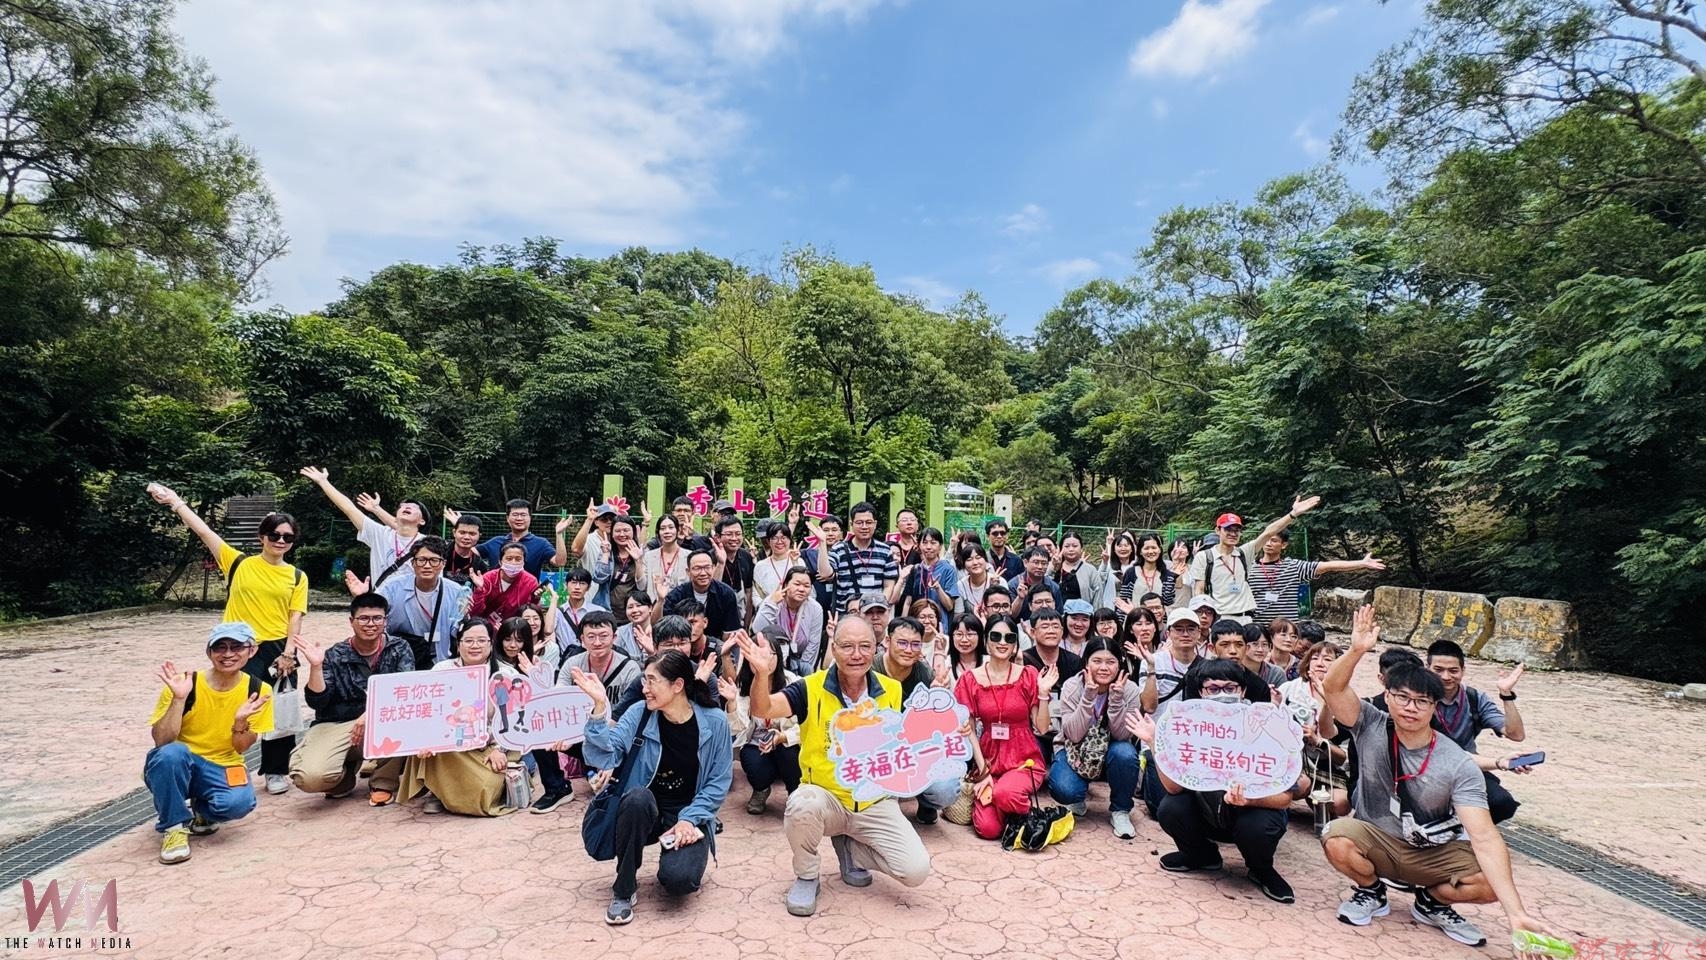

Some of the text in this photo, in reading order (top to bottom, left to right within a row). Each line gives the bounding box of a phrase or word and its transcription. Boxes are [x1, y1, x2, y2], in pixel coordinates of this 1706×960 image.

[686, 484, 829, 519] 香山步道
[1172, 716, 1237, 740] 我們的
[841, 736, 967, 783] 幸福在一起
[1178, 742, 1277, 778] 幸福約定
